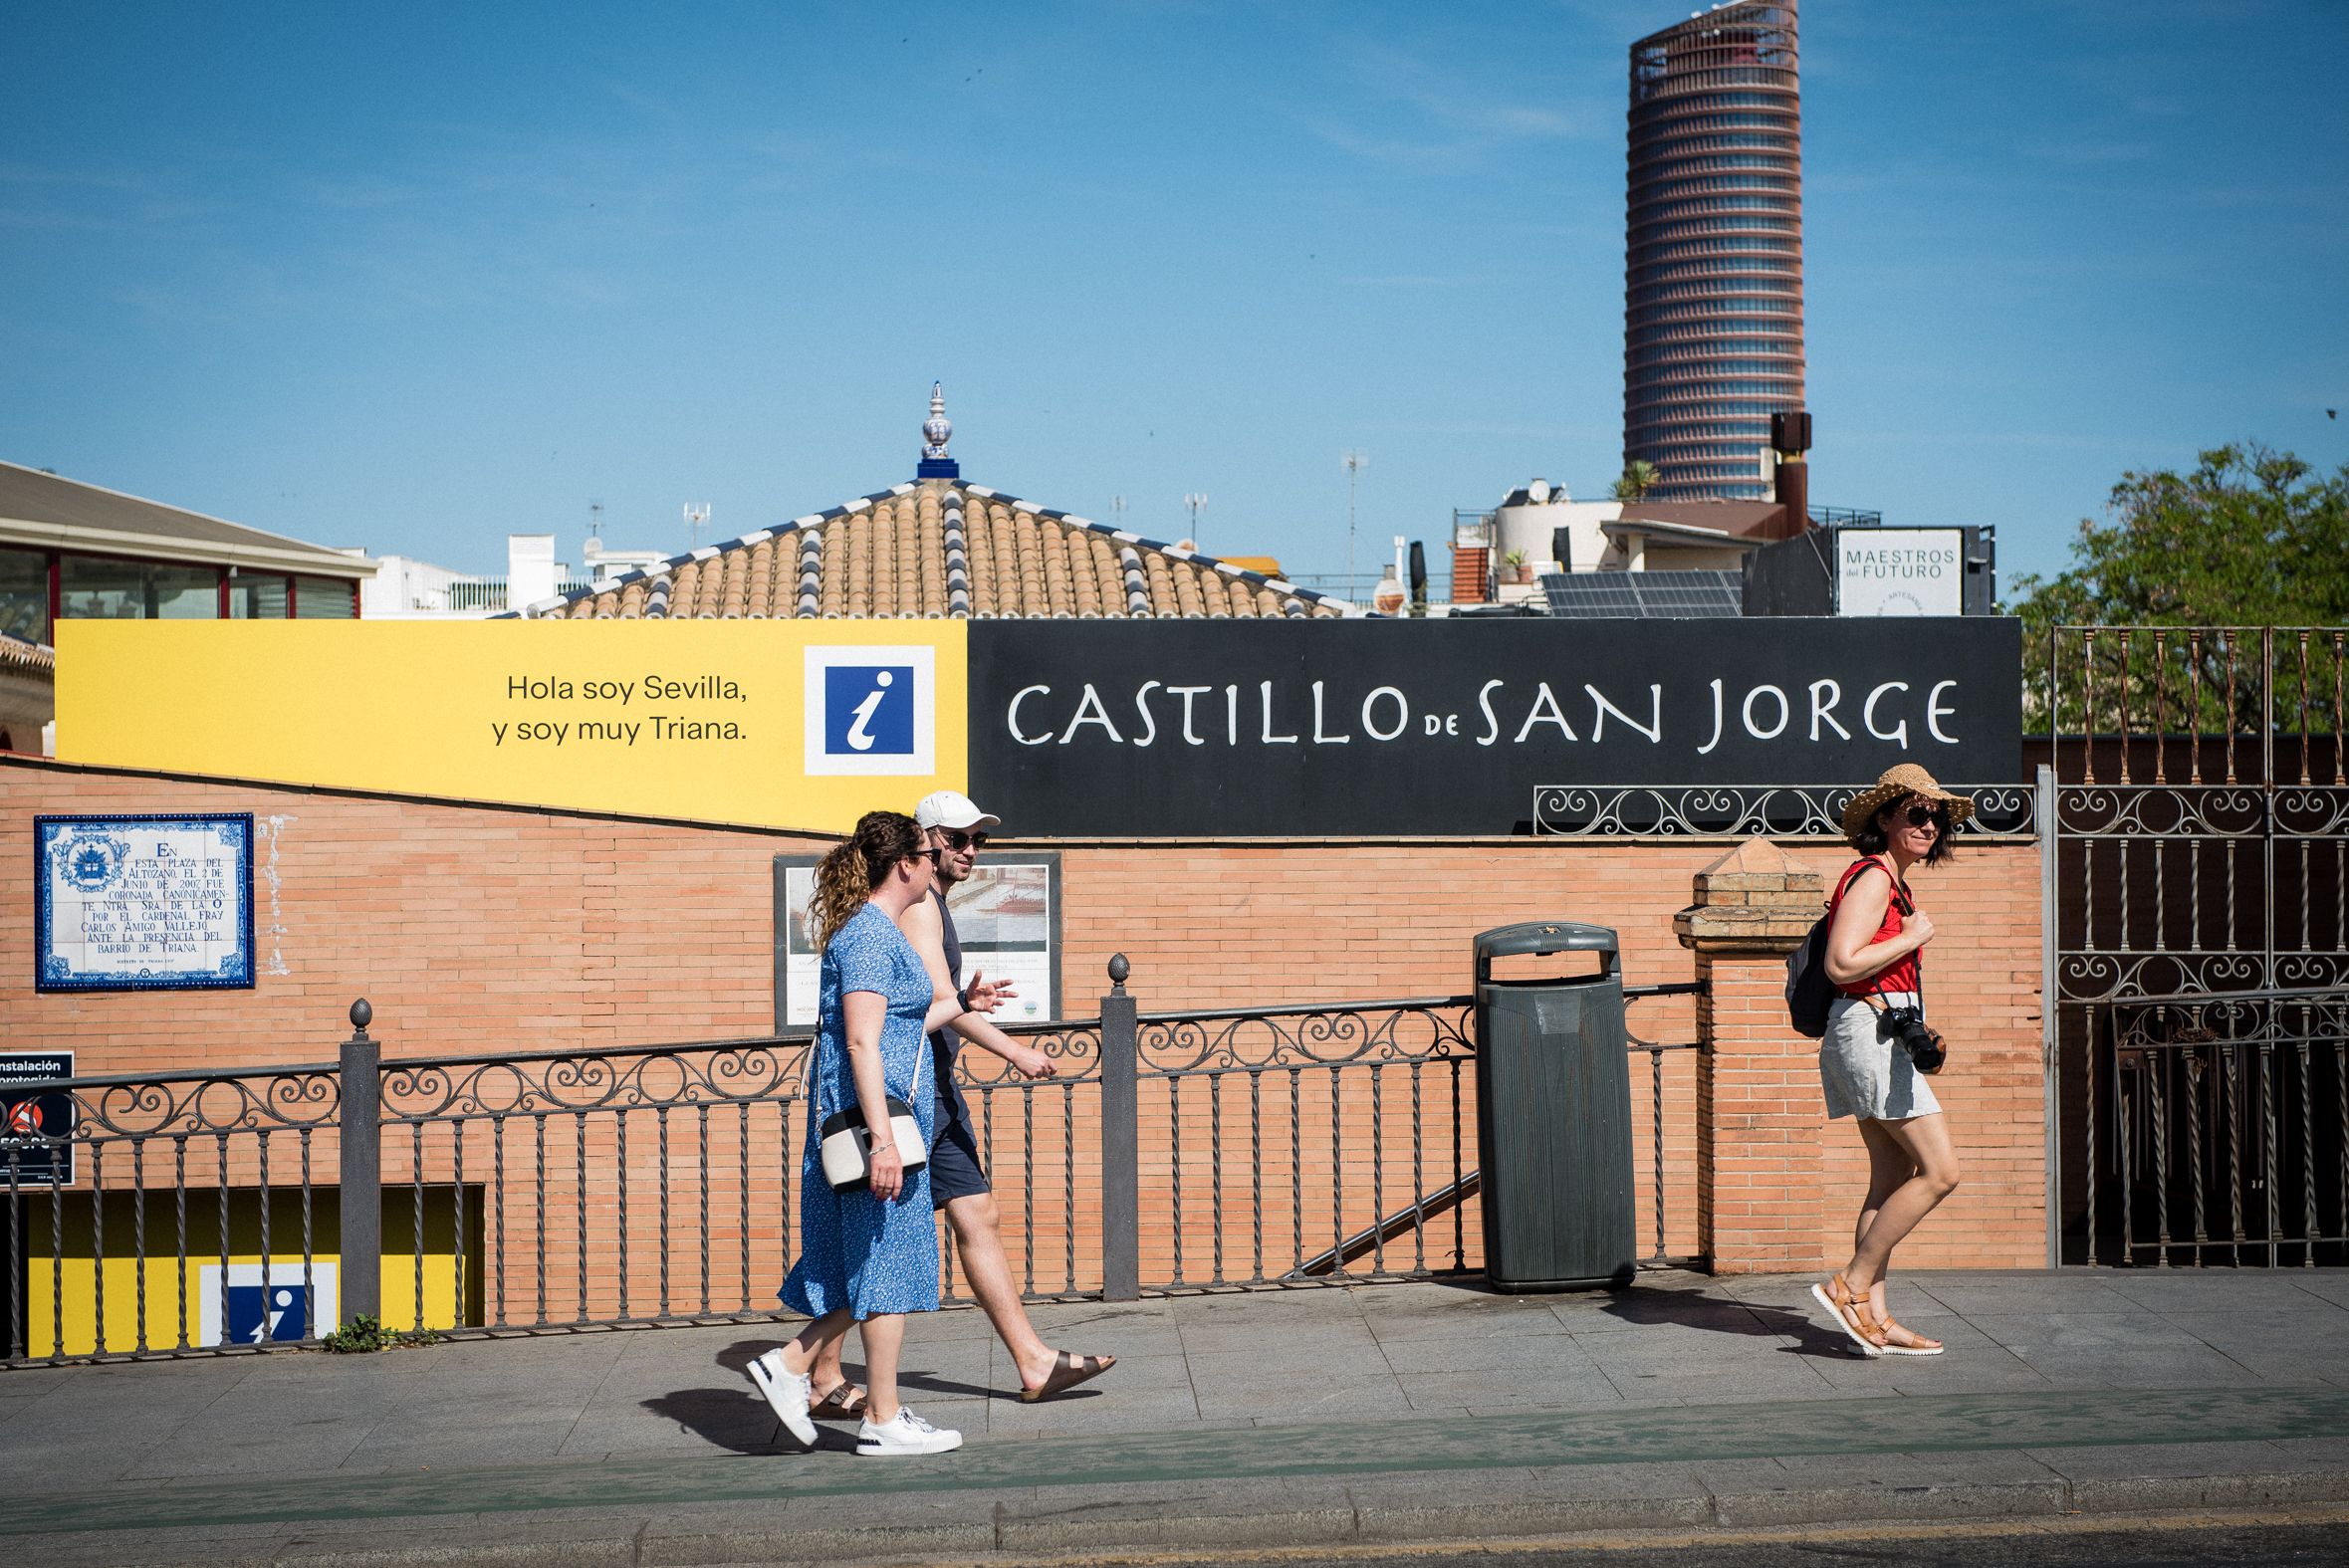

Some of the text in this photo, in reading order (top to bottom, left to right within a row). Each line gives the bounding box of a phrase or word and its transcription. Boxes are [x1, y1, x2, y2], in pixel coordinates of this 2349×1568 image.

[1846, 550, 1954, 563] MAESTROS
[1863, 565, 1942, 578] FUTURO
[508, 675, 747, 706] Hola soy Sevilla,
[1008, 678, 1960, 755] CASTILLO DE SAN JORGE
[491, 716, 747, 747] y soy muy Triana.
[135, 858, 223, 868] ESTA PLAZA DEL
[184, 869, 196, 878] EL
[202, 869, 207, 878] 2
[121, 879, 147, 889] JUNIO
[157, 880, 168, 889] DE
[110, 891, 152, 900] CORONADA
[171, 901, 182, 910] DE
[192, 901, 204, 910] LA
[142, 912, 189, 921] CARDENAL
[199, 911, 223, 920] FRAY
[82, 922, 117, 932] CARLOS
[125, 922, 155, 932] AMIGO
[88, 934, 113, 943] ANTE
[144, 933, 194, 942] PRESENCIA
[204, 932, 222, 941] DEL
[99, 944, 130, 953] BARRIO
[139, 944, 151, 953] DE
[0, 1060, 61, 1071] nstalación
